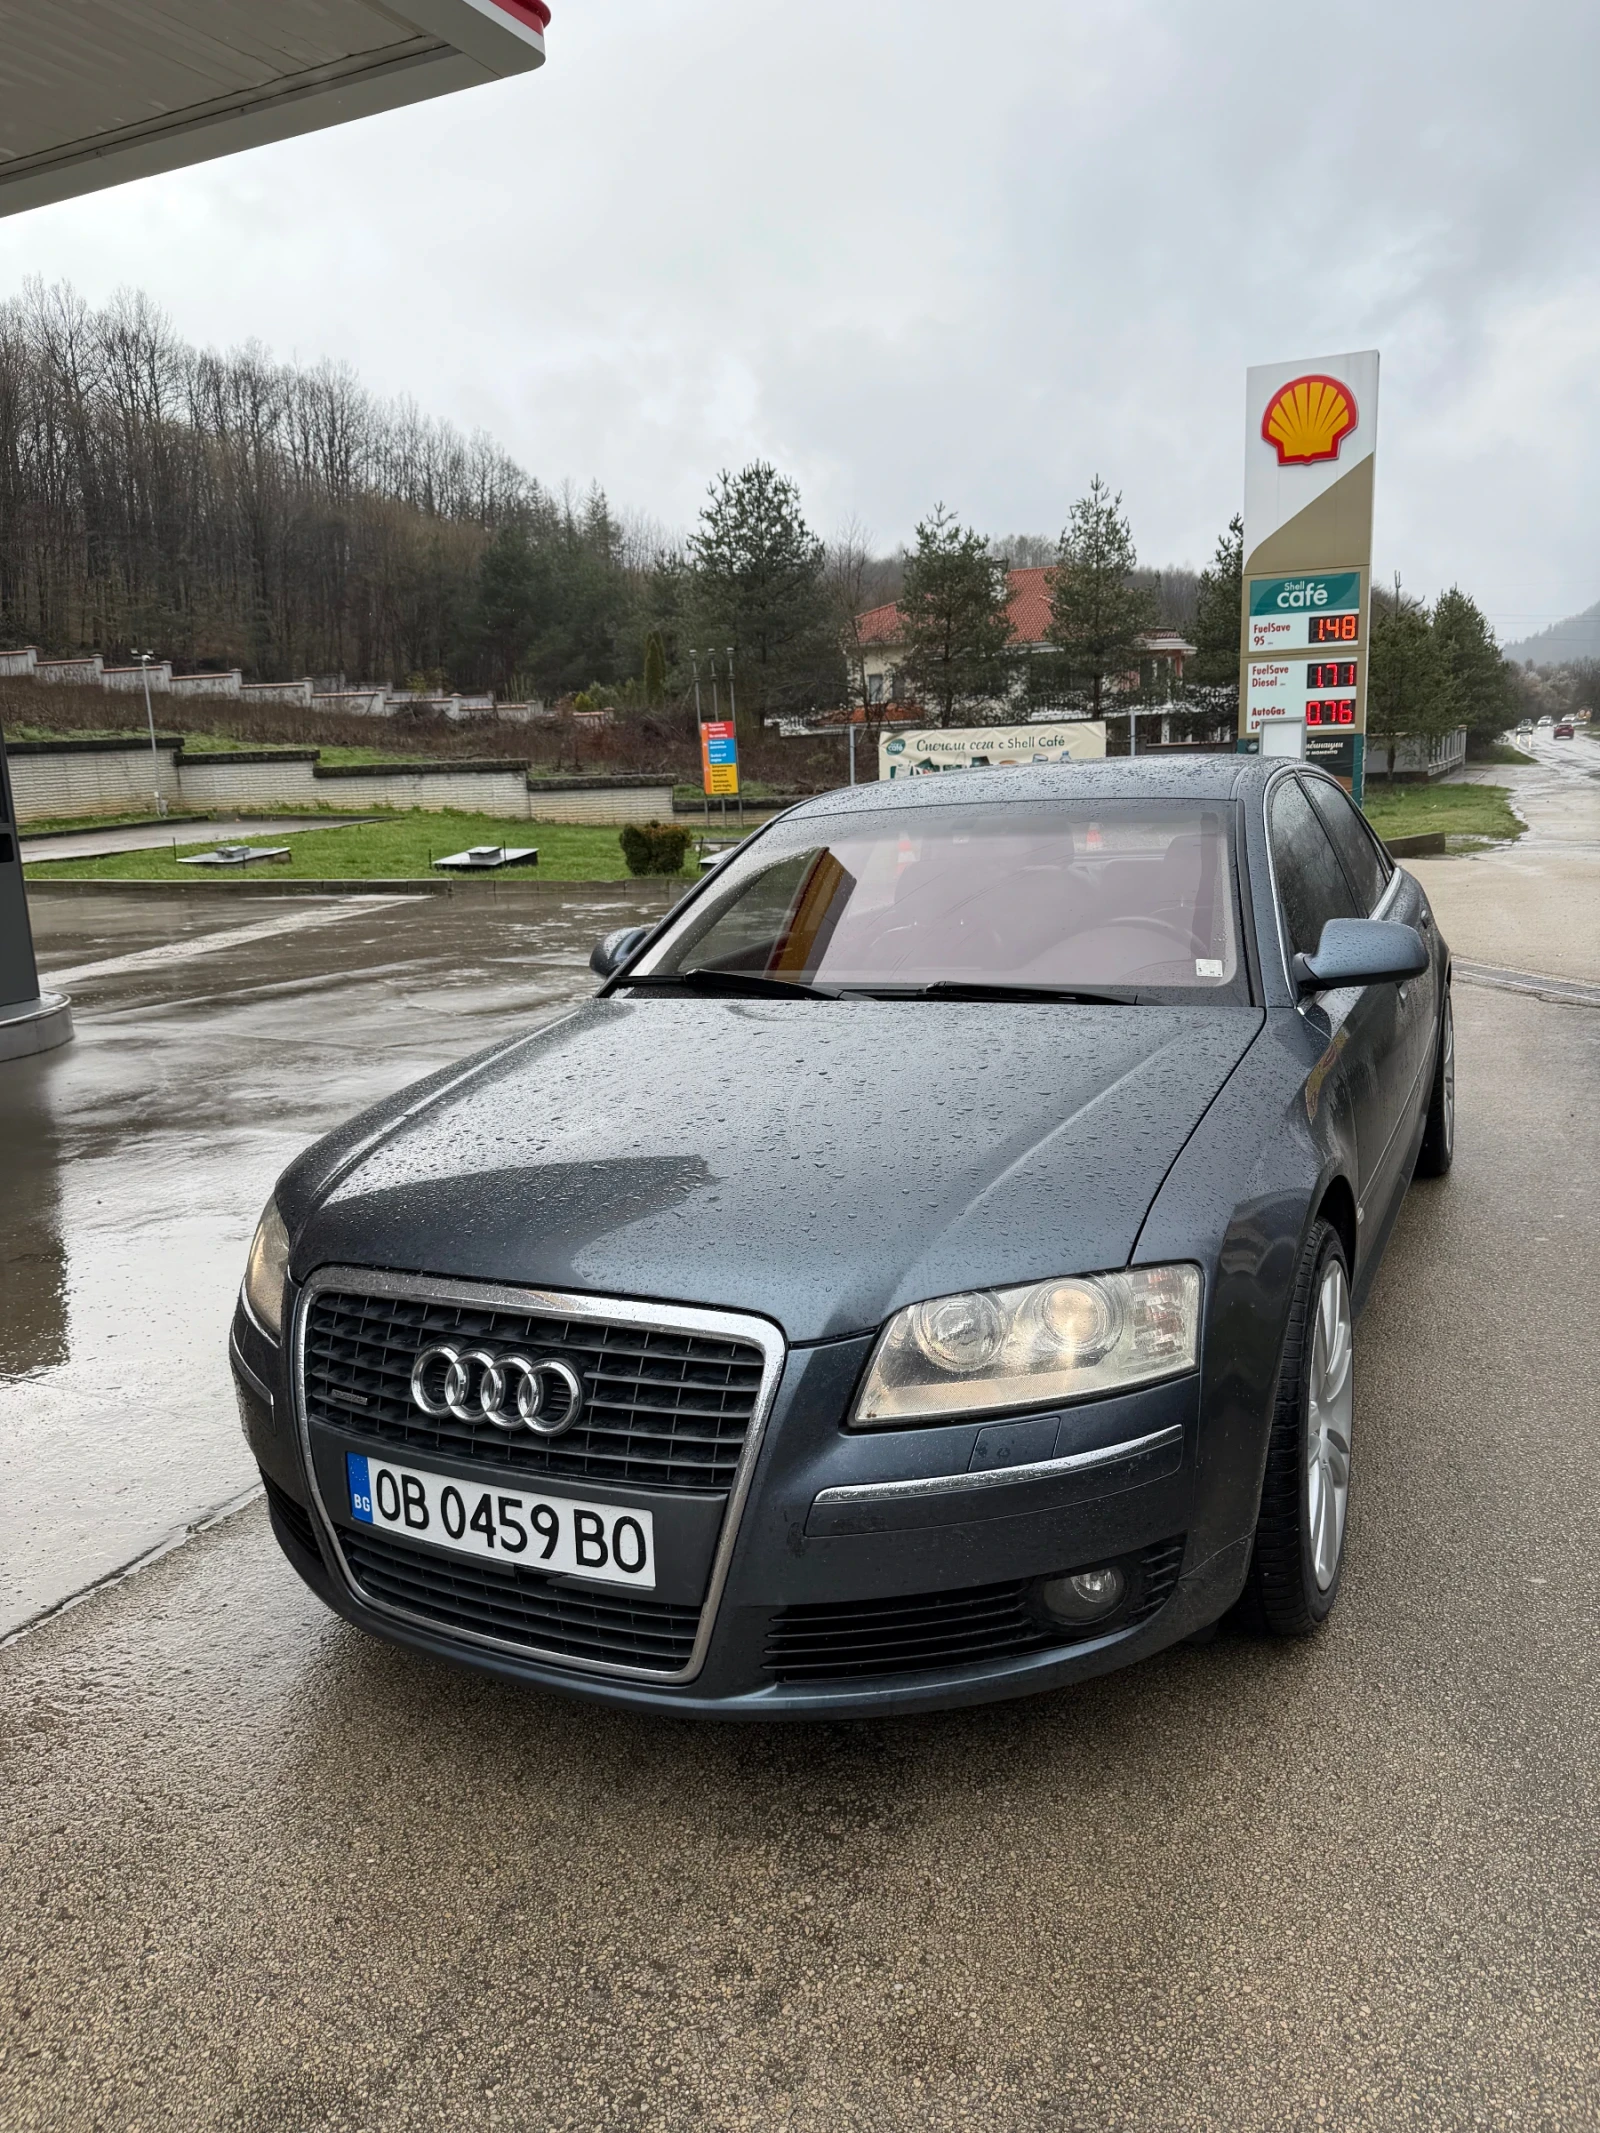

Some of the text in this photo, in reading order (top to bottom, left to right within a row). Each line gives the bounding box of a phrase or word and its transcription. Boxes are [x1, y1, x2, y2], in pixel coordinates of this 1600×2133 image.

[1284, 581, 1305, 591] Shell
[1277, 583, 1328, 608] café
[1253, 622, 1291, 634] FuelSave
[1253, 635, 1265, 646] 95
[1252, 664, 1289, 676] FuelSave
[1252, 676, 1278, 688] Diesel
[1251, 706, 1286, 717] AutoGas
[1250, 720, 1261, 730] LP
[916, 739, 966, 752] Спечели
[969, 741, 994, 750] сега
[1007, 736, 1035, 749] Shell
[1038, 735, 1065, 747] Café
[353, 1493, 371, 1512] BG
[376, 1469, 647, 1573] OB 0459 BO
